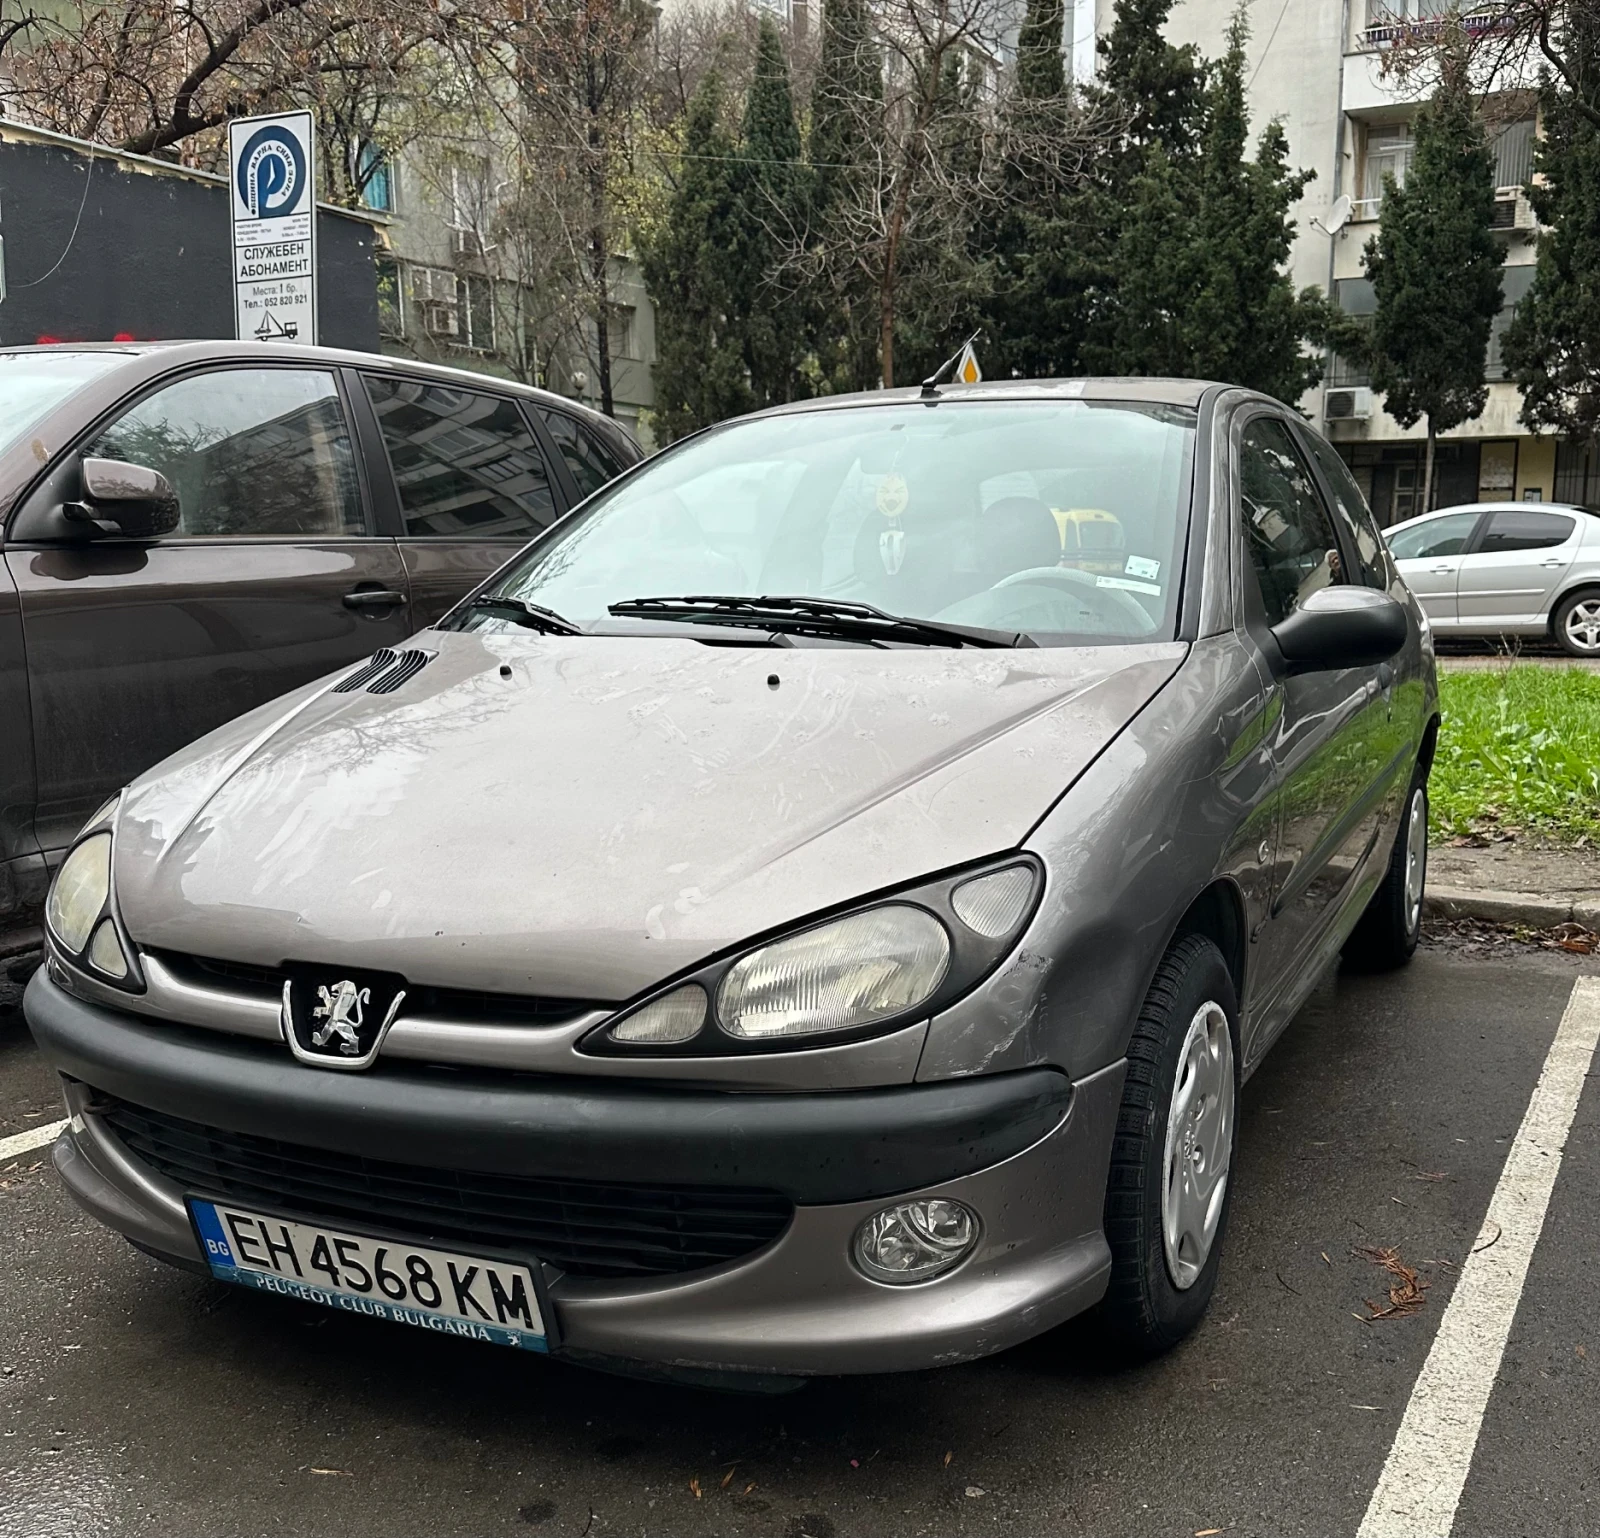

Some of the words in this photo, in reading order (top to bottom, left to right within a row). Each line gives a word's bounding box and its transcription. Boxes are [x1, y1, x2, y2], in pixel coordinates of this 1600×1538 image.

[244, 242, 304, 260] СЛУЖЕБЕН
[240, 258, 309, 277] АБОНАМЕНТ
[252, 286, 278, 296] Места:
[286, 283, 298, 294] бр.
[243, 299, 263, 309] Тел.:
[264, 297, 278, 307] 052
[279, 295, 293, 306] 820
[294, 294, 308, 305] 921
[206, 1238, 229, 1256] BG
[224, 1212, 303, 1277] EH
[310, 1234, 442, 1308] 4568
[447, 1261, 534, 1329] KM
[256, 1276, 334, 1305] PEUGEOT
[339, 1296, 387, 1318] CLUB
[393, 1308, 492, 1341] BULGARIA
